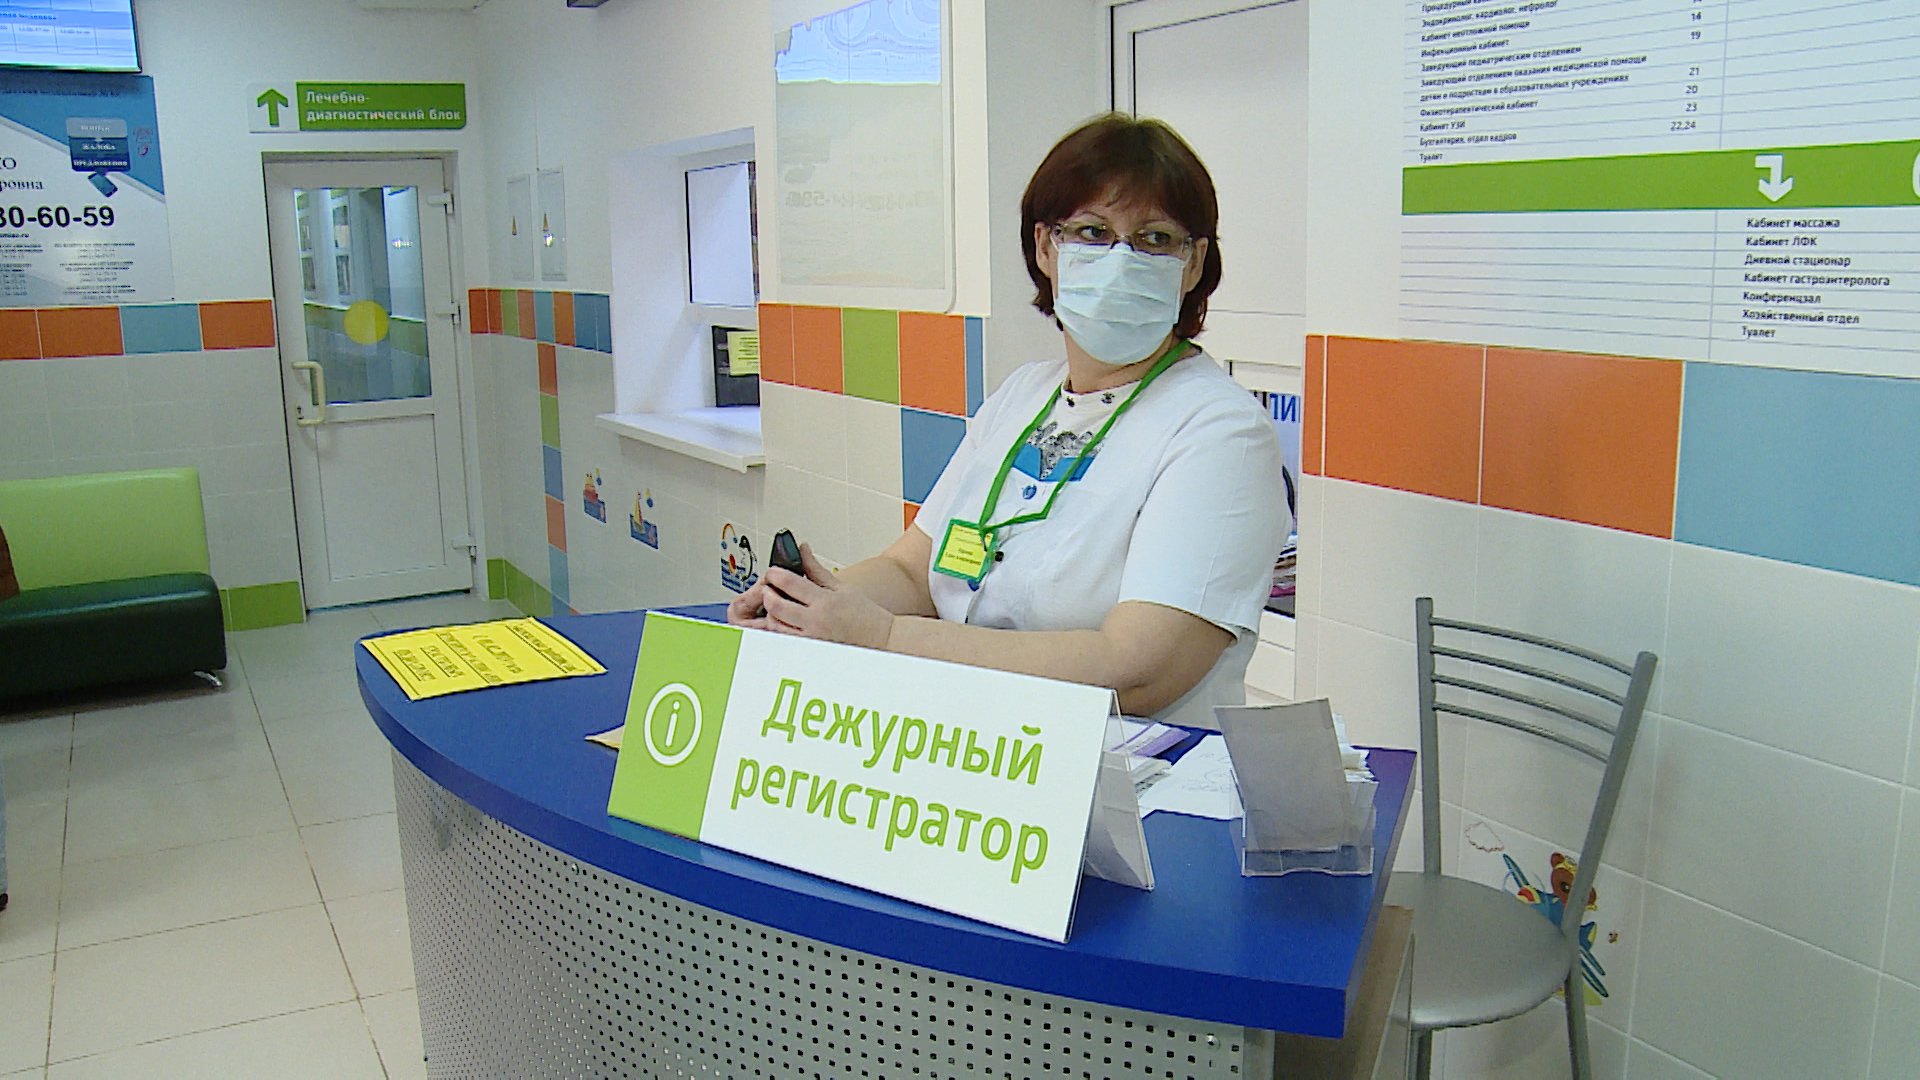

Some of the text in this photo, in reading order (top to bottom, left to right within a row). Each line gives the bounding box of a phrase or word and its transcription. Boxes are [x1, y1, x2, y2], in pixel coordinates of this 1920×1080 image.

[1421, 21, 1530, 42] Кабинет неотложной помощи
[1690, 31, 1701, 40] 19
[1421, 39, 1510, 57] Инфекционный кабинет
[1421, 46, 1582, 72] Заведующий педиатрическим отделением
[1421, 55, 1647, 88] Заведующий отделением оказания медицинской помощи
[1689, 67, 1700, 76] 21
[1449, 88, 1493, 100] подросткам
[1499, 81, 1569, 94] образовательных
[1571, 74, 1629, 89] учреждениях
[1685, 85, 1698, 94] 20
[305, 89, 370, 104] Лечебно-
[306, 107, 461, 122] диагностический блок
[1420, 99, 1538, 116] Физиотерапевтический кабинет
[1685, 103, 1697, 112] 23
[1420, 120, 1465, 132] Кабинет УЗИ
[1467, 134, 1489, 143] отдел
[1490, 133, 1517, 142] кадров
[1420, 153, 1443, 163] Туалет
[1747, 217, 1840, 228] Кабинет массажа
[1746, 235, 1817, 246] Кабинет ЛФК
[1744, 253, 1851, 268] Дневной стационар
[1744, 273, 1890, 288] Кабинет гастроэнтеролога
[1743, 291, 1822, 304] Конференцзал
[1742, 309, 1860, 324] Хозяйственный отдел
[1741, 325, 1776, 341] Туалет
[761, 678, 1044, 786] Дежурный
[729, 755, 1050, 885] регистратор
